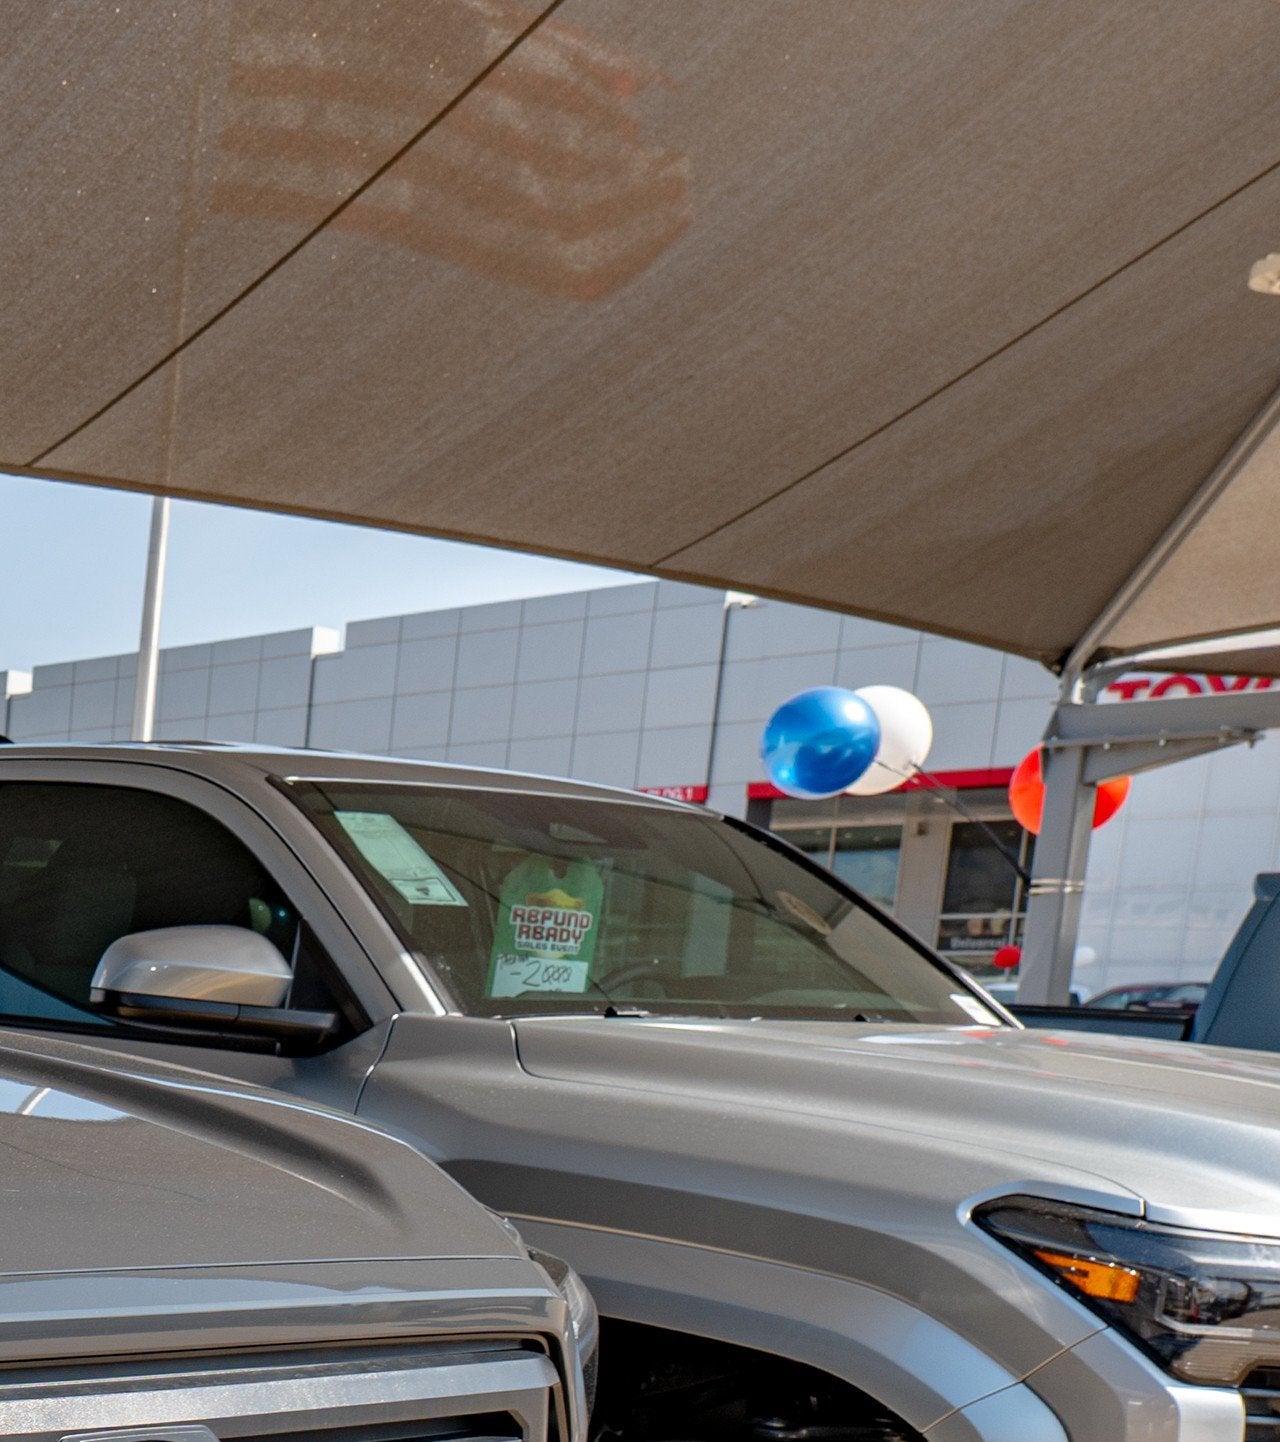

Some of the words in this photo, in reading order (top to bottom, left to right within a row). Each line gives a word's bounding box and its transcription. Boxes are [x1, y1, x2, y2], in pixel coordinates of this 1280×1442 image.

[511, 907, 592, 930] REFUND
[517, 924, 584, 944] READY
[516, 940, 548, 951] SALES
[550, 942, 579, 955] EVENT
